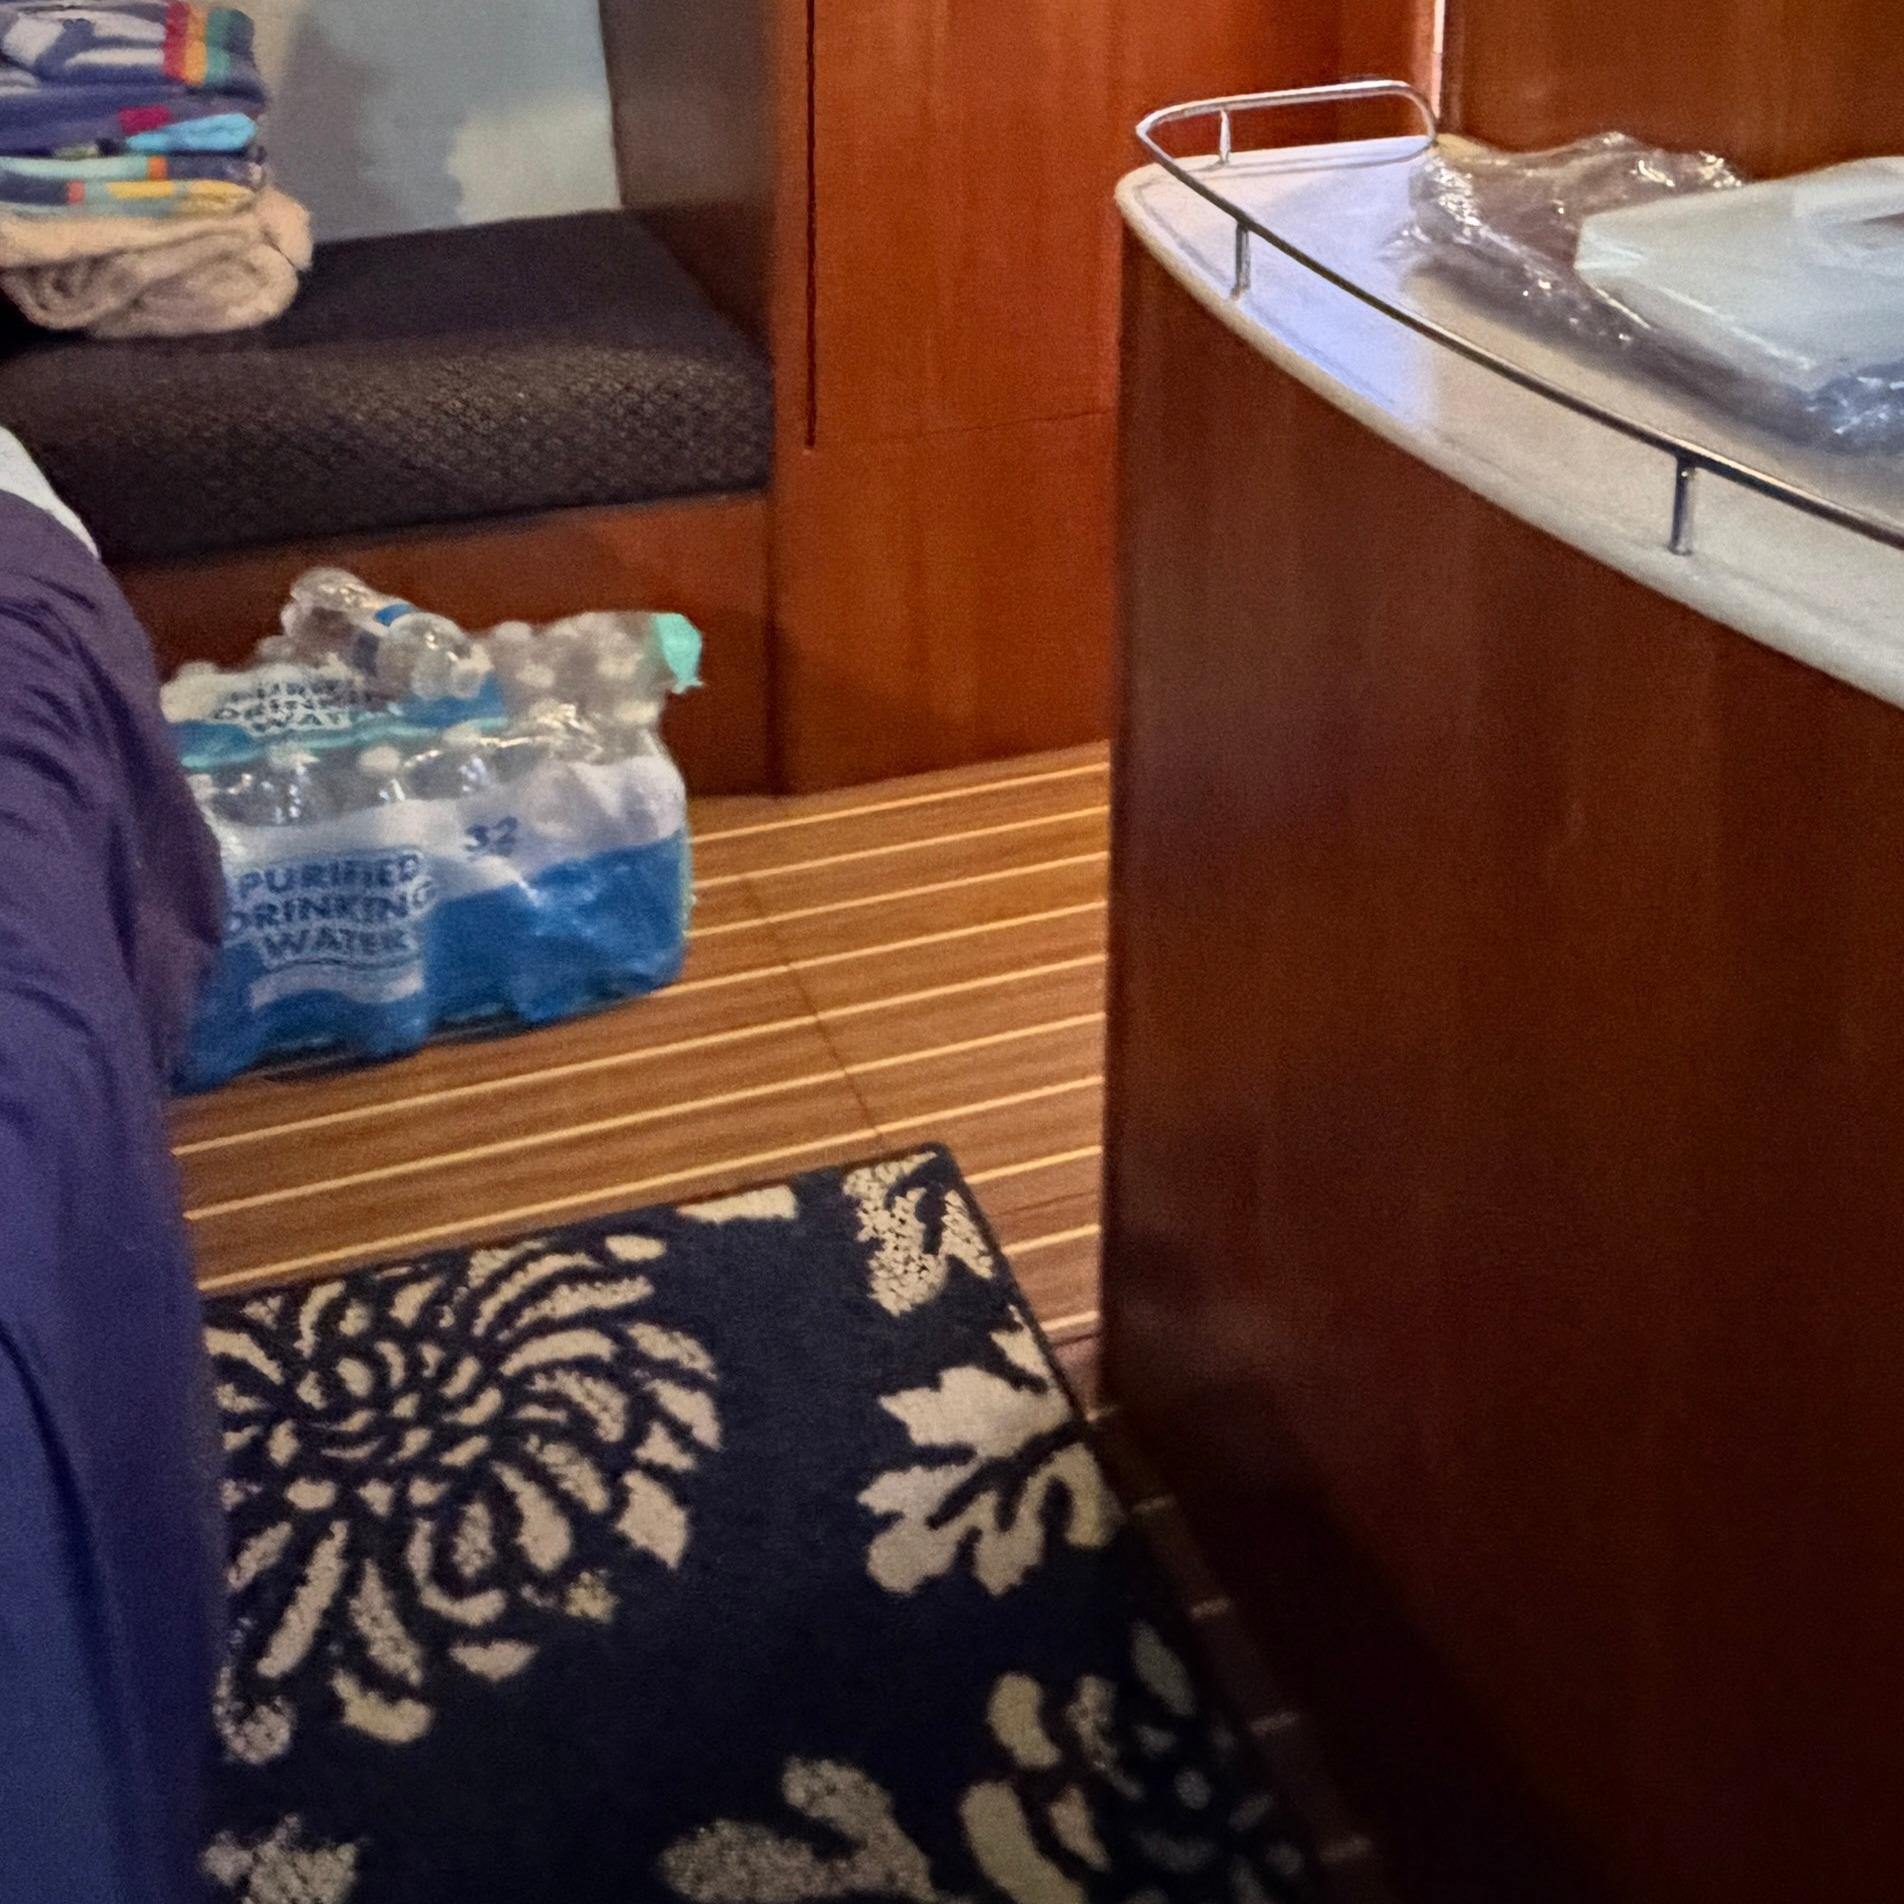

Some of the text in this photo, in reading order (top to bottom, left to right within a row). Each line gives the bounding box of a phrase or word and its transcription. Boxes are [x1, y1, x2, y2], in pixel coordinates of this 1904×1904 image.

[465, 816, 518, 857] 32
[238, 853, 420, 897] PURIFIED
[225, 881, 434, 943] DRINKING
